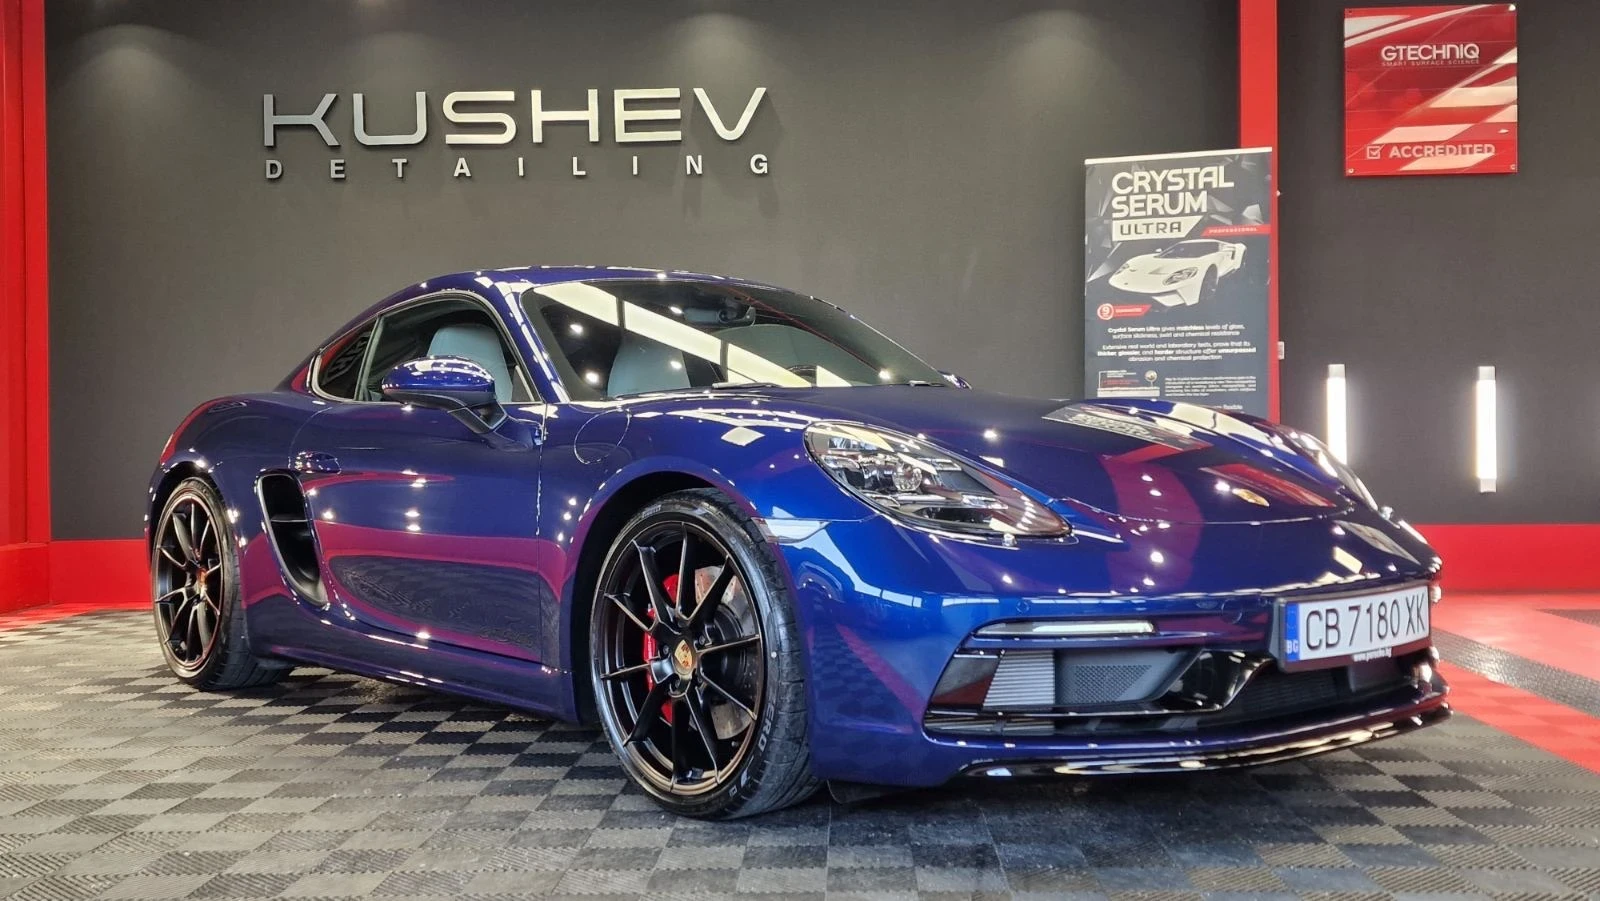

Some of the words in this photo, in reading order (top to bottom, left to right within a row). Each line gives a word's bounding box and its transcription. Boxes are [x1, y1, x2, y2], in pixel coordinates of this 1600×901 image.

[1381, 43, 1480, 61] GTECHNIQ
[263, 87, 767, 147] KUSHEV
[1388, 144, 1496, 158] ACCREDITED
[265, 154, 768, 179] DETAILING
[1111, 165, 1235, 194] CRYSTAL
[1111, 190, 1208, 218] SERUM
[1120, 221, 1182, 236] ULTRA
[1305, 608, 1341, 650] CB
[1348, 598, 1401, 648] 7180
[1405, 592, 1426, 637] XK
[1286, 639, 1299, 655] BG
